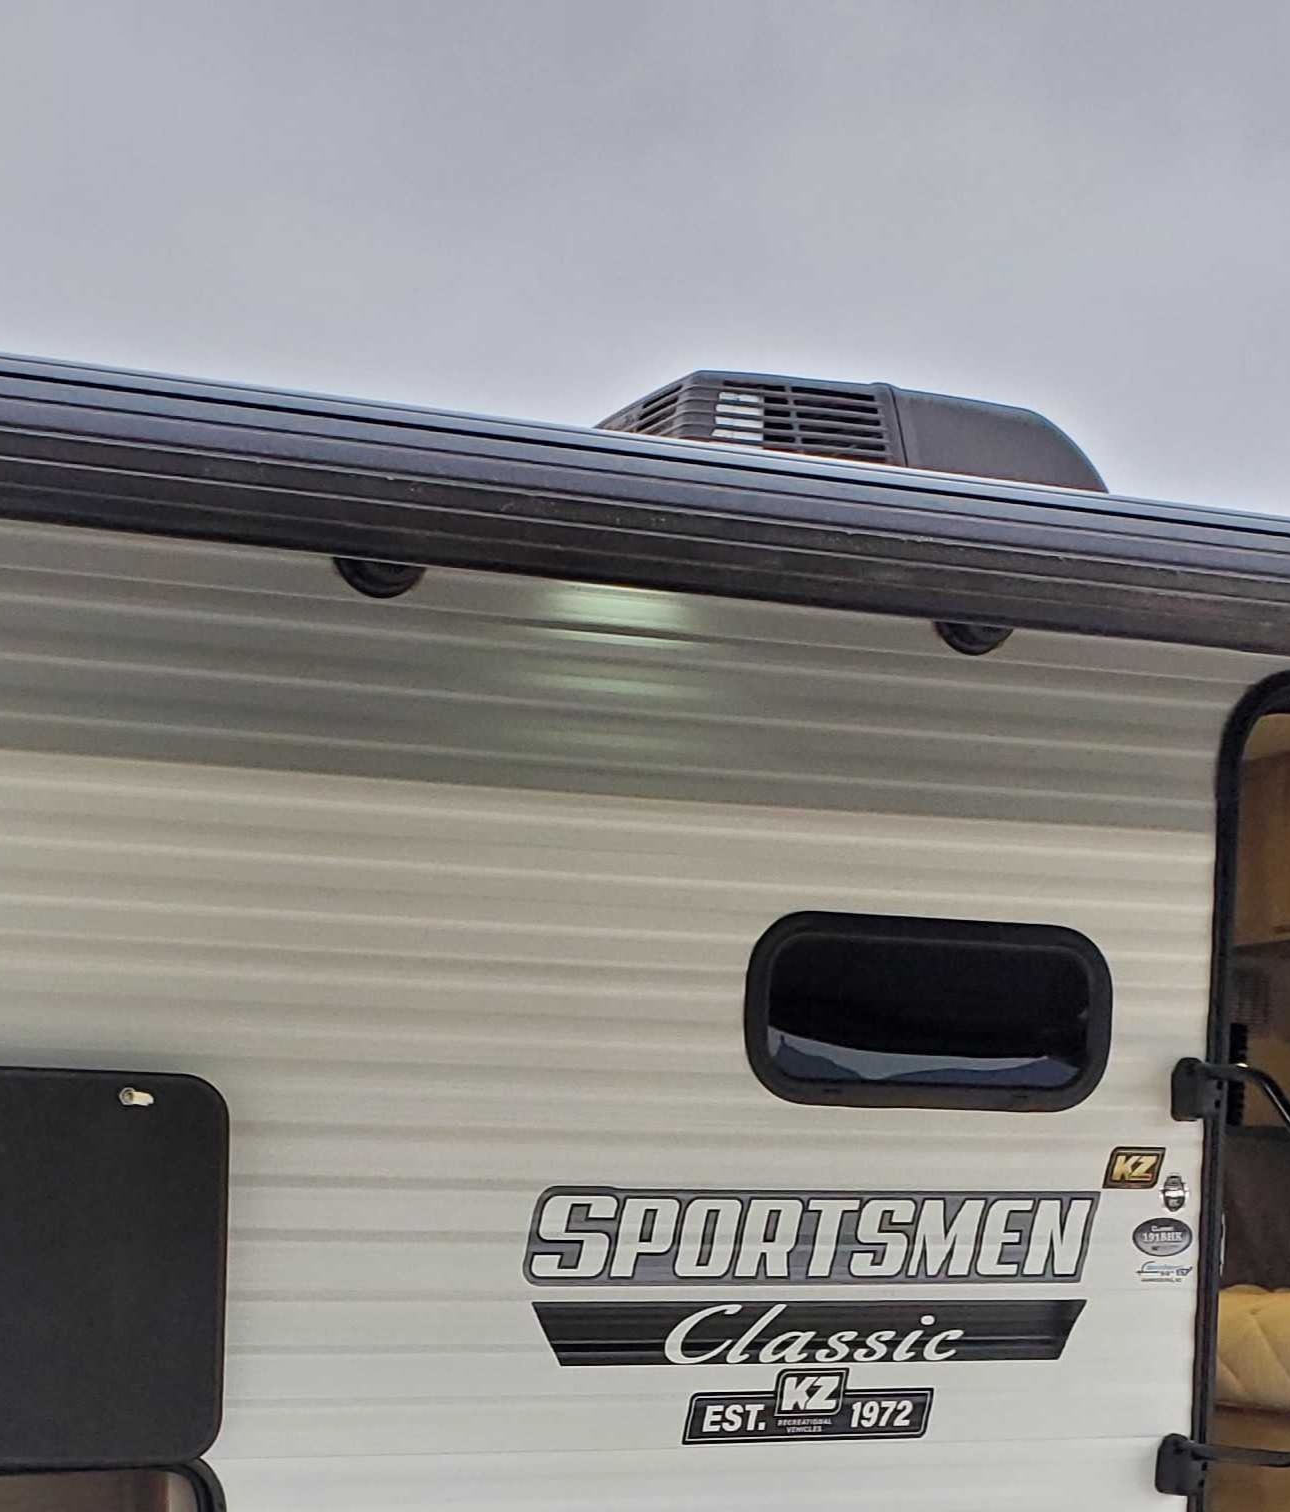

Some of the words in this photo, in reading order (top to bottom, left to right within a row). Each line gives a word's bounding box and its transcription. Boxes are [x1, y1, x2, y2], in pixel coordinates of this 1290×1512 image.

[1111, 1155, 1158, 1181] KZ
[529, 1194, 1095, 1279] SPORTSMEN
[664, 1303, 965, 1364] Classic
[780, 1375, 841, 1411] KZ
[701, 1403, 766, 1433] EST.
[850, 1400, 914, 1428] 1972
